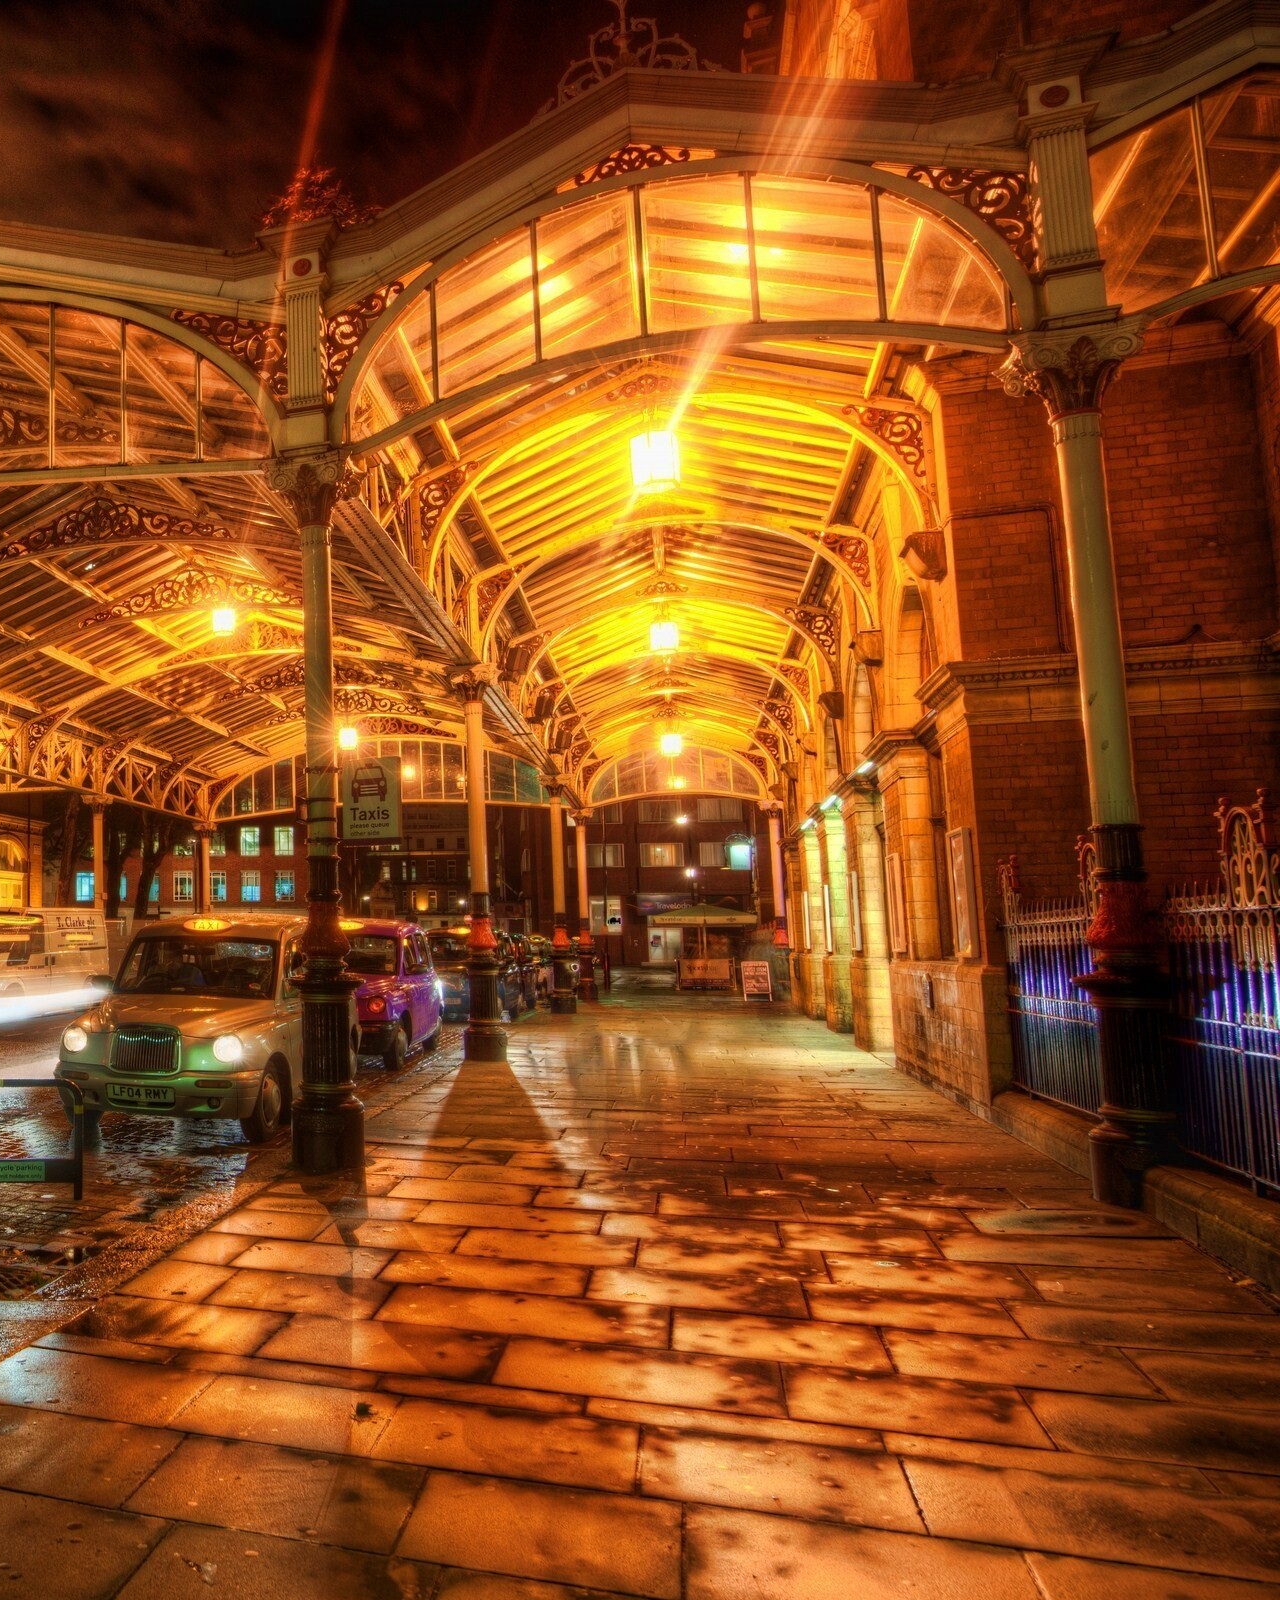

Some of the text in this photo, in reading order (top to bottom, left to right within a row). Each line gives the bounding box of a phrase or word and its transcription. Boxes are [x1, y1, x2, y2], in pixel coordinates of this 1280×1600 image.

[350, 806, 390, 821] Taxis
[56, 917, 64, 928] T.
[65, 916, 86, 928] Clarke
[193, 922, 221, 930] TAXI
[112, 1085, 168, 1100] LF04 RMY
